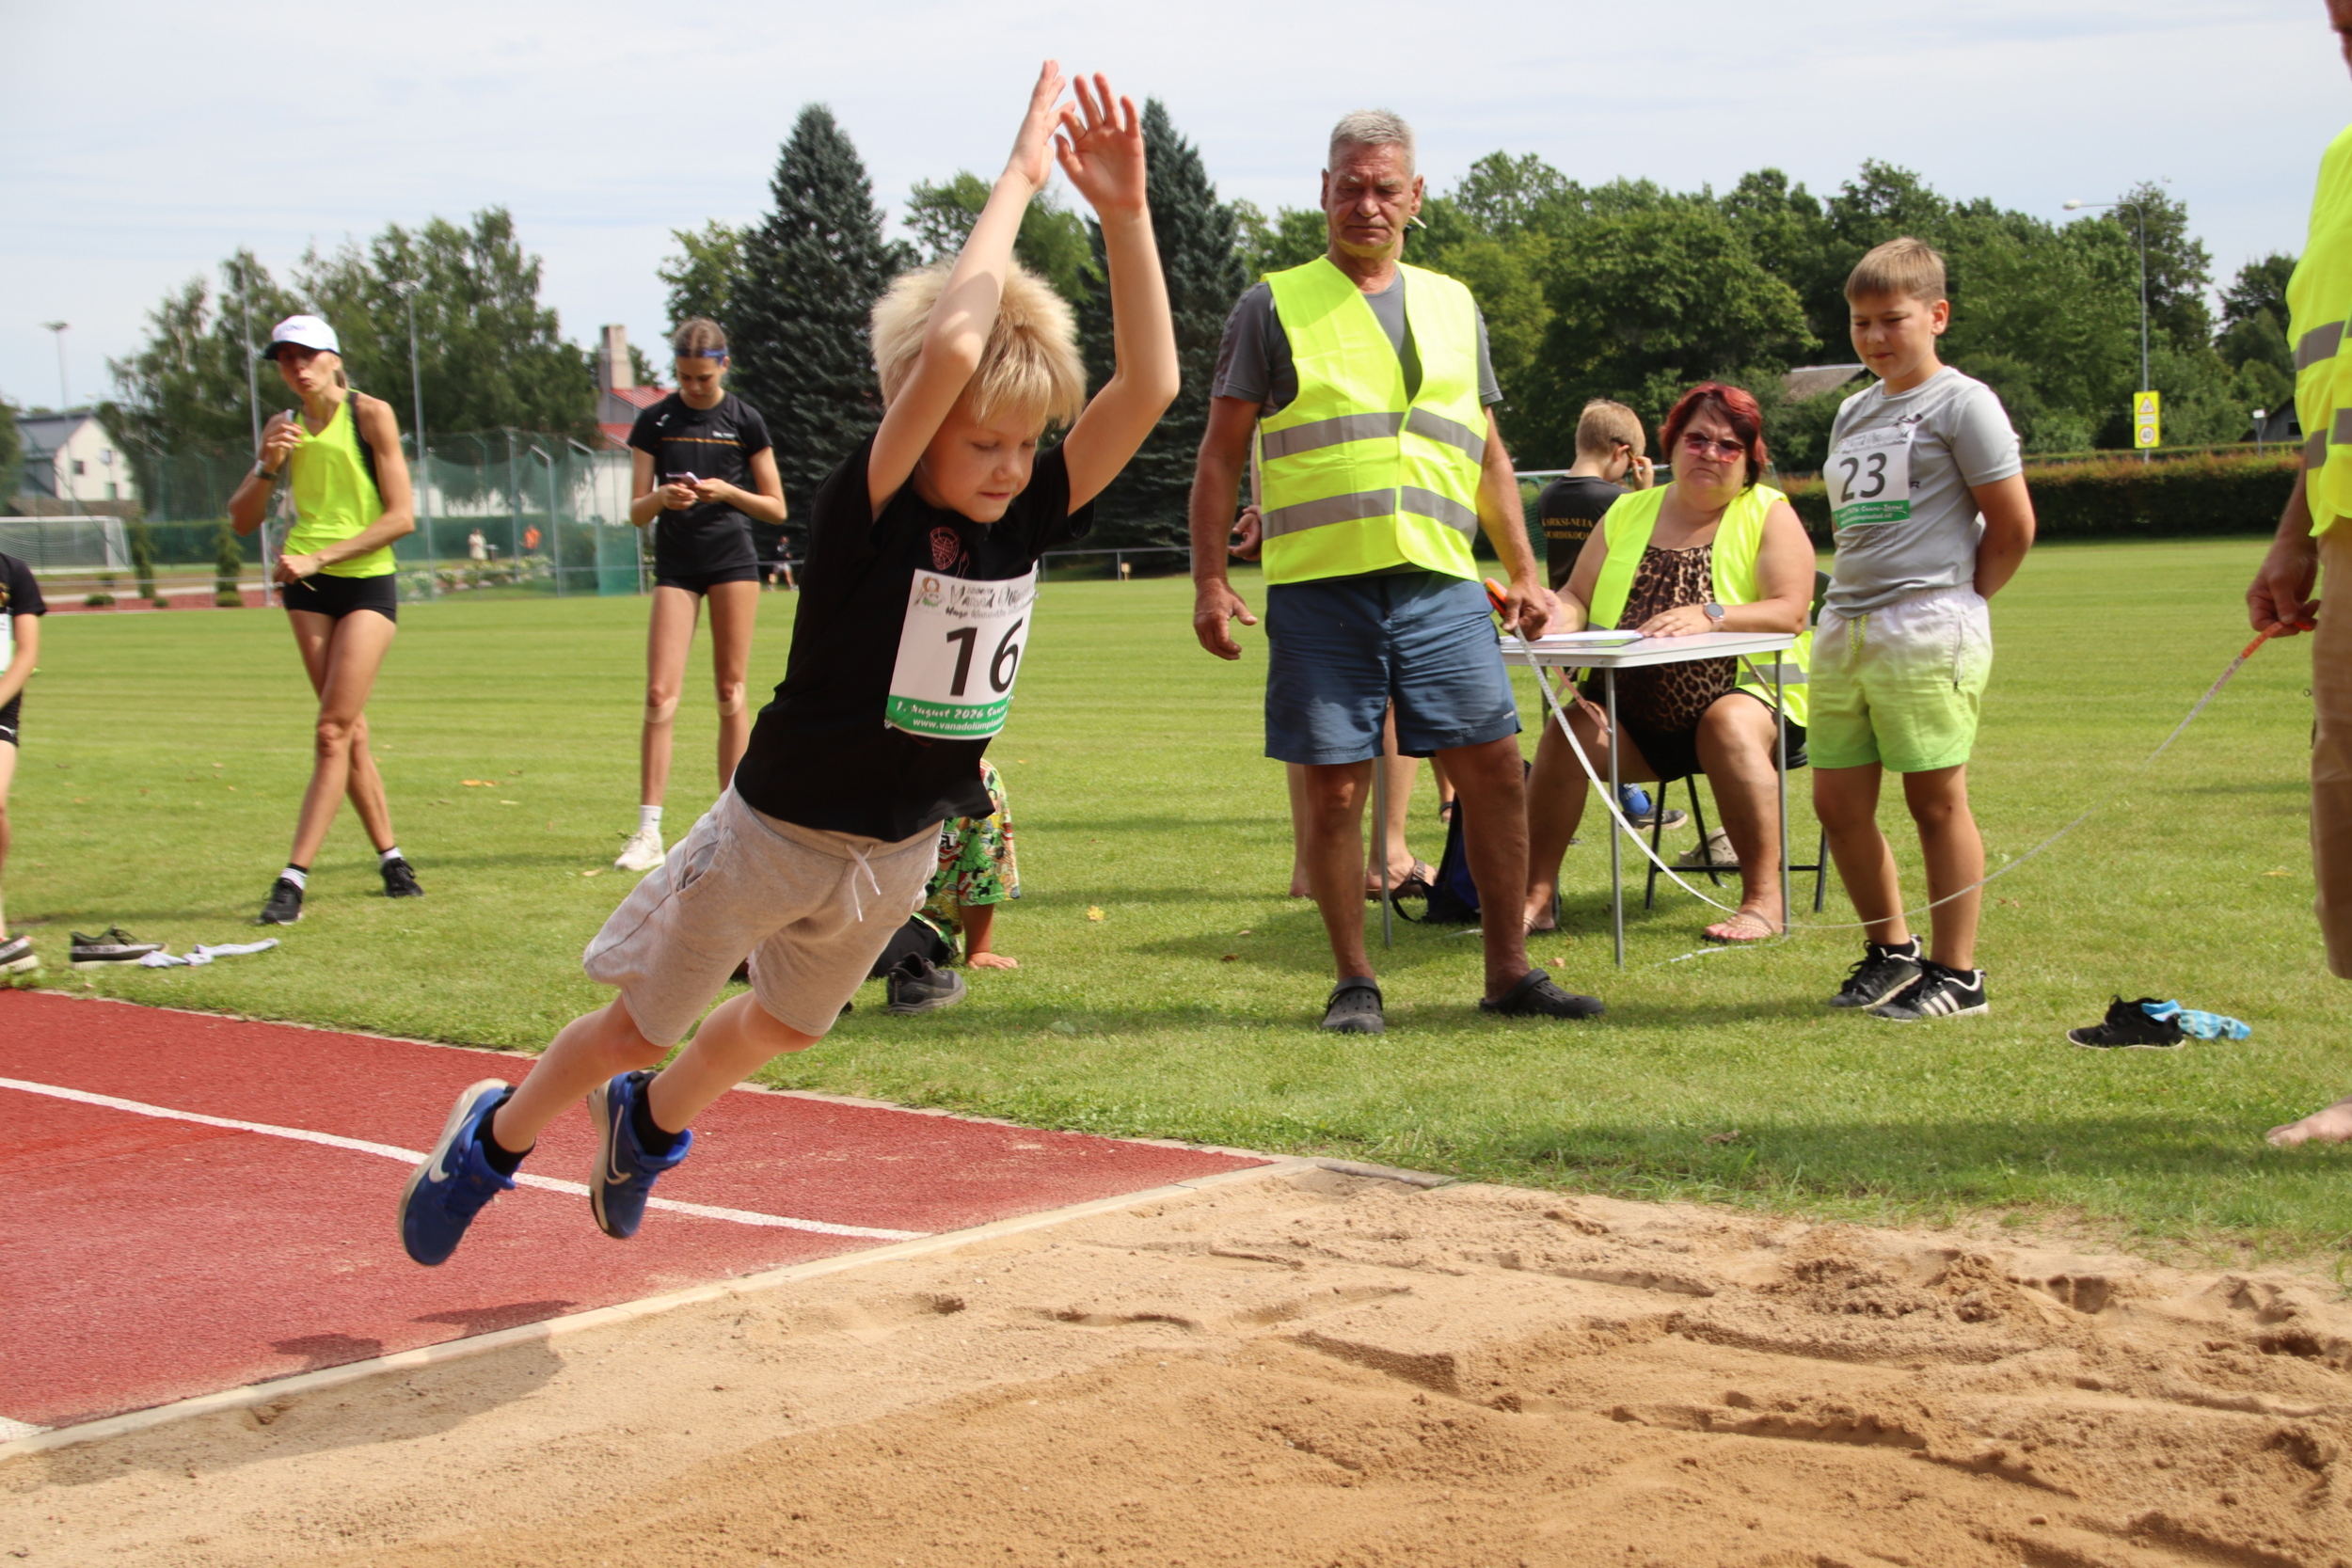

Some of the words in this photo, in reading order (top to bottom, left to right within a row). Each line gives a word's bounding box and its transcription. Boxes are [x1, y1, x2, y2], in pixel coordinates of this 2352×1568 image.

[1839, 452, 1887, 503] 23
[946, 616, 1024, 697] 16
[954, 708, 984, 720] 2026
